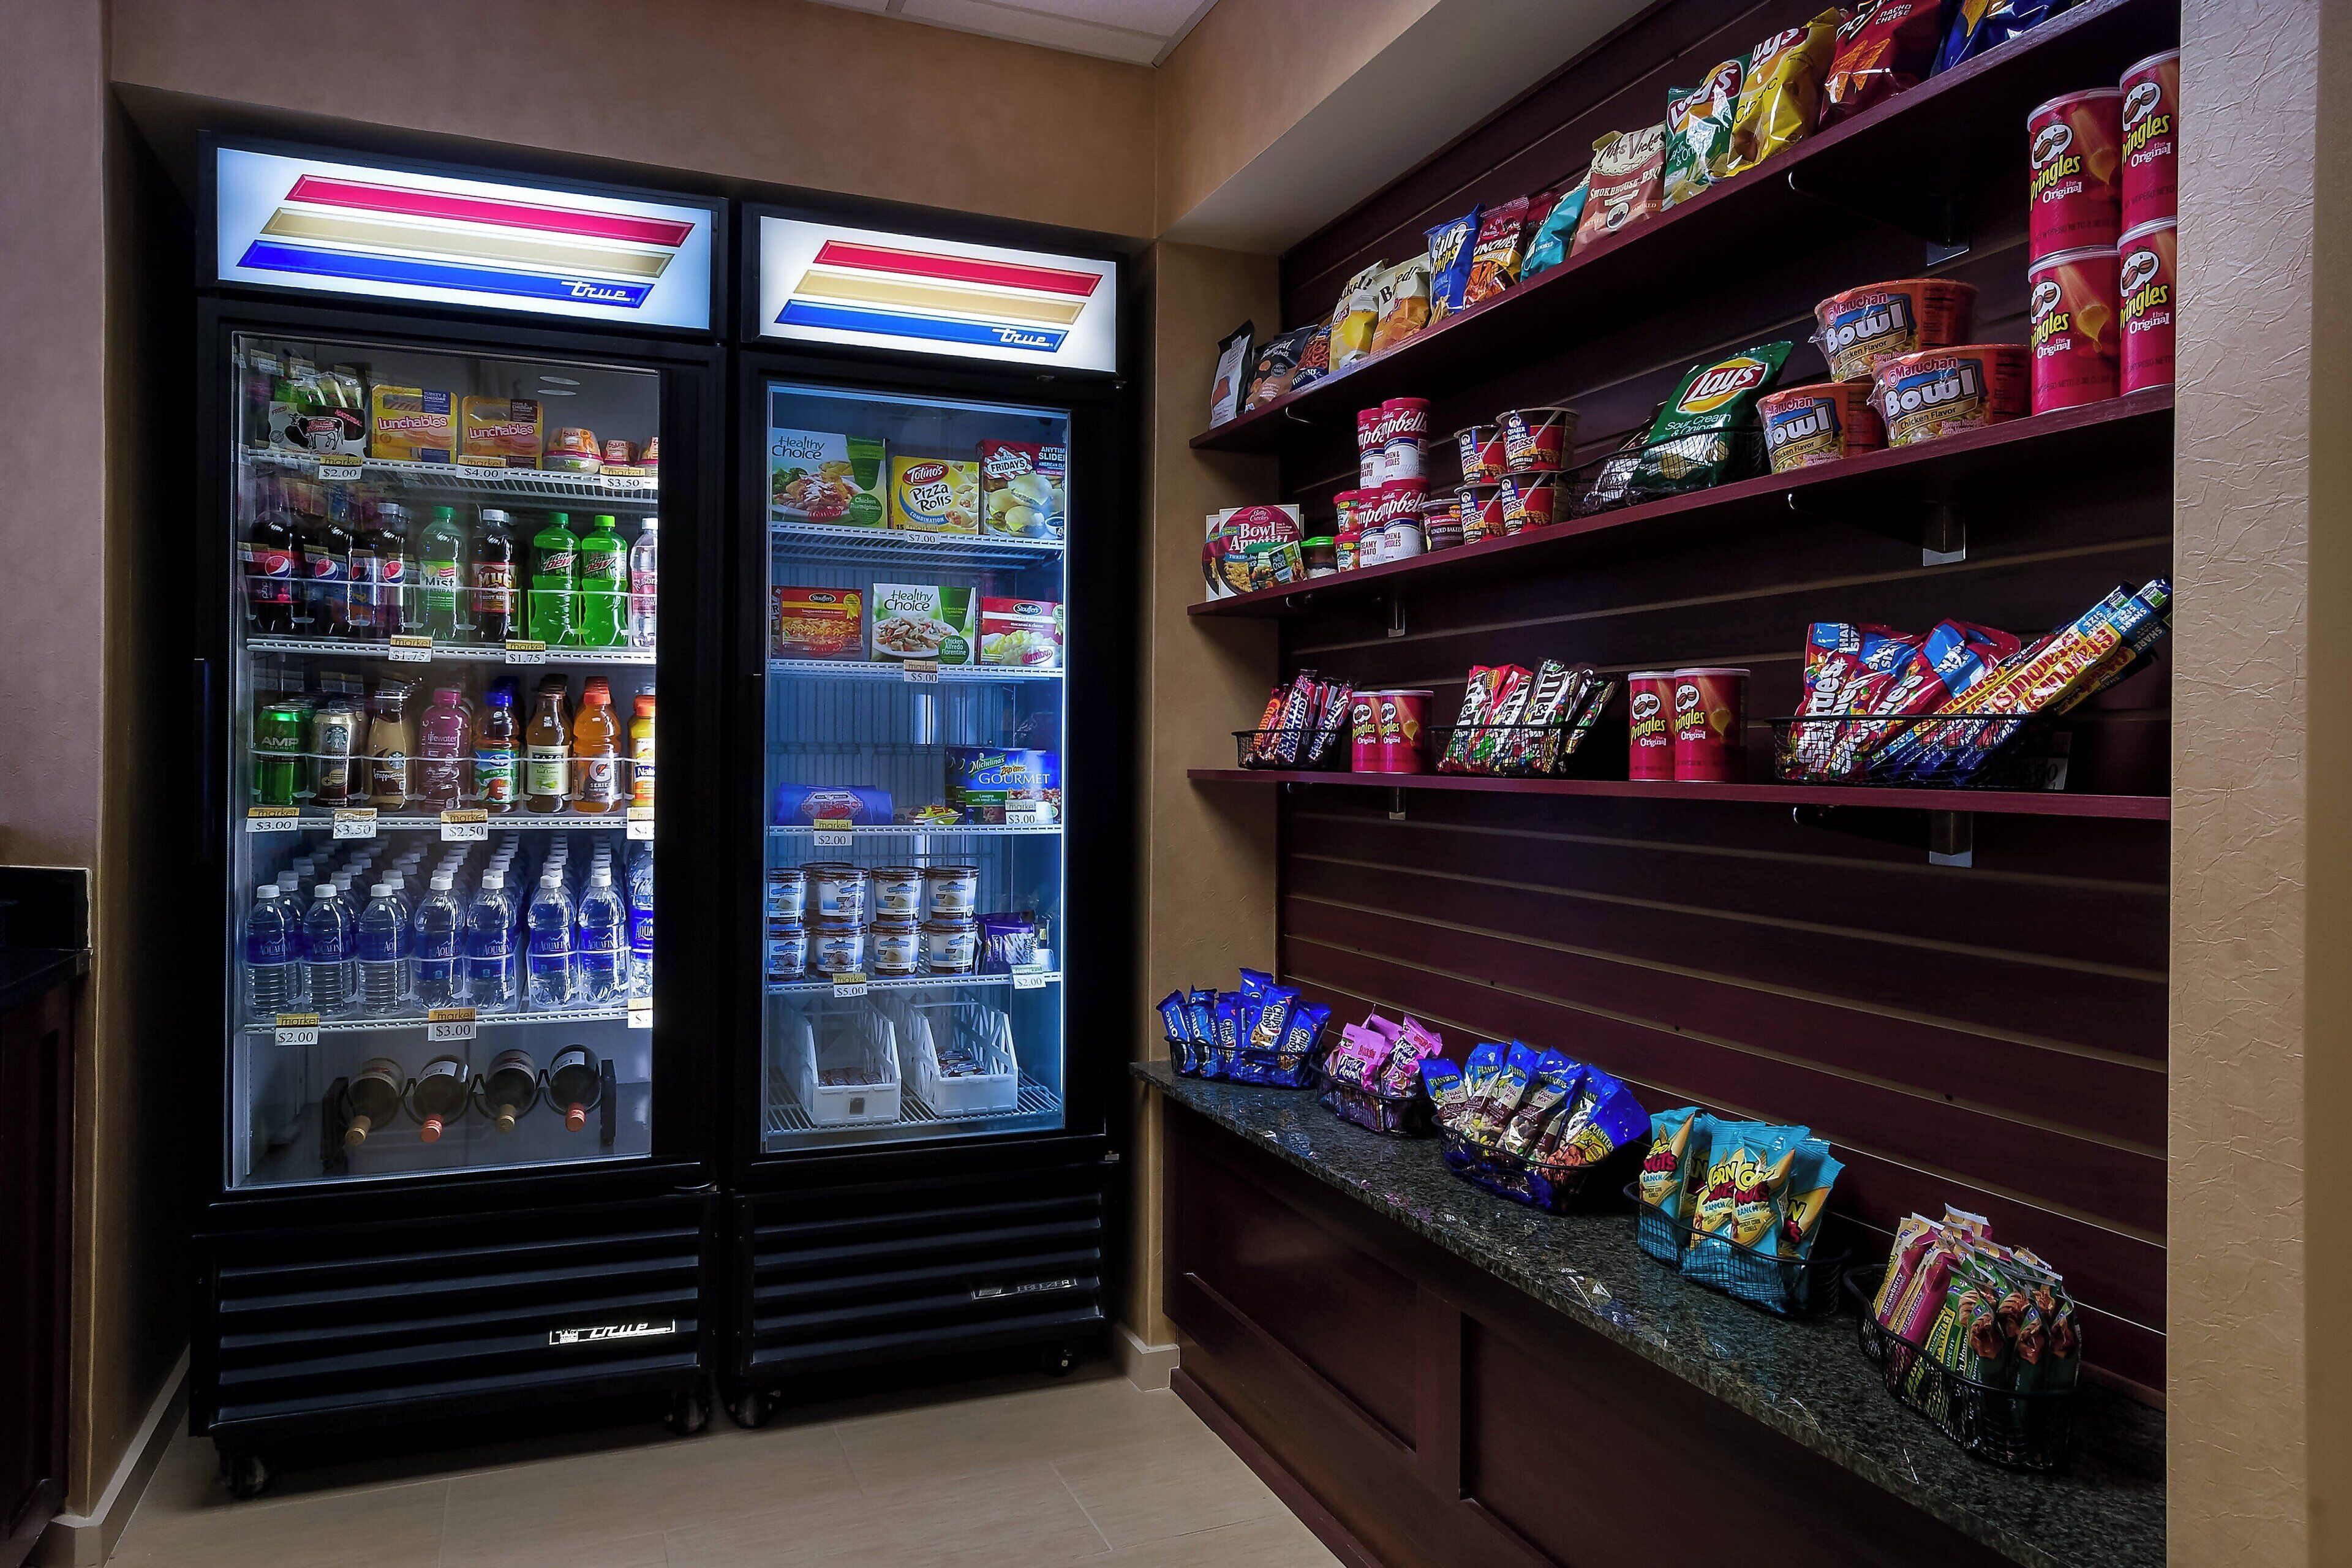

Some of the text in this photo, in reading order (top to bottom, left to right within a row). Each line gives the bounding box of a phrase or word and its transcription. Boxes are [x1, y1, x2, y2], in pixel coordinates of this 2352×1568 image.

[1875, 9, 1909, 25] CHEESE
[2122, 114, 2169, 163] ringles
[2131, 142, 2171, 167] Original
[2030, 154, 2081, 211] Pringles
[2042, 182, 2082, 203] Original
[560, 281, 631, 303] true
[1834, 292, 1888, 315] Maruchan
[2120, 283, 2168, 337] ringles
[1826, 299, 1906, 355] Bowl
[2130, 312, 2169, 334] Original
[992, 327, 1051, 347] true
[2031, 311, 2069, 353] ringles
[1838, 339, 1888, 366] Chicken Flavor
[2037, 339, 2071, 359] Original
[1896, 358, 1958, 378] Maruchan
[1684, 366, 1763, 404] Lay's
[1885, 364, 1977, 417] Bowl
[378, 415, 448, 431] Lunchables
[1665, 413, 1732, 431] Sour Cream
[1900, 407, 1956, 430] Chicken Flavor
[468, 424, 534, 439] Lunchables
[1765, 404, 1831, 450] Bowl
[778, 435, 825, 451] Healthy
[1794, 440, 1815, 453] Flavor
[772, 445, 822, 459] Choice
[464, 468, 499, 478] $4.00
[991, 459, 1025, 472] FRiDAYS
[608, 478, 639, 487] $3.50
[907, 466, 943, 483] Totino's
[910, 483, 949, 501] Pizza
[917, 494, 952, 513] Rolls
[910, 511, 944, 523] COMBINATION
[908, 534, 935, 543] $7.00
[1239, 522, 1275, 539] Bowl
[891, 588, 933, 602] Healthy
[884, 598, 930, 612] Choice
[509, 654, 540, 663] $1.75
[911, 673, 937, 682] $5.00
[1630, 716, 1665, 745] Pringles
[1681, 731, 1706, 741] Original
[261, 736, 299, 746] AMP
[1640, 738, 1666, 747] Original
[978, 773, 1050, 785] GOURMET
[256, 821, 292, 830] $3.00
[448, 813, 485, 823] market
[1008, 815, 1035, 824] $3.00
[449, 825, 484, 837] $2.50
[818, 836, 846, 845] $2.00
[1017, 978, 1042, 986] $2.00
[837, 987, 864, 996] $5.00
[437, 1010, 473, 1021] market
[1262, 1006, 1273, 1030] Ahoy
[1270, 1005, 1285, 1034] Chips
[277, 1031, 314, 1043] $2.00
[436, 1025, 471, 1036] $3.00
[1539, 1090, 1554, 1101] TRAIL
[1589, 1122, 1615, 1152] PLANTERS
[1705, 1201, 1726, 1212] RANCH
[1737, 1205, 1759, 1216] RANCH
[1881, 1272, 1904, 1315] Strawberry
